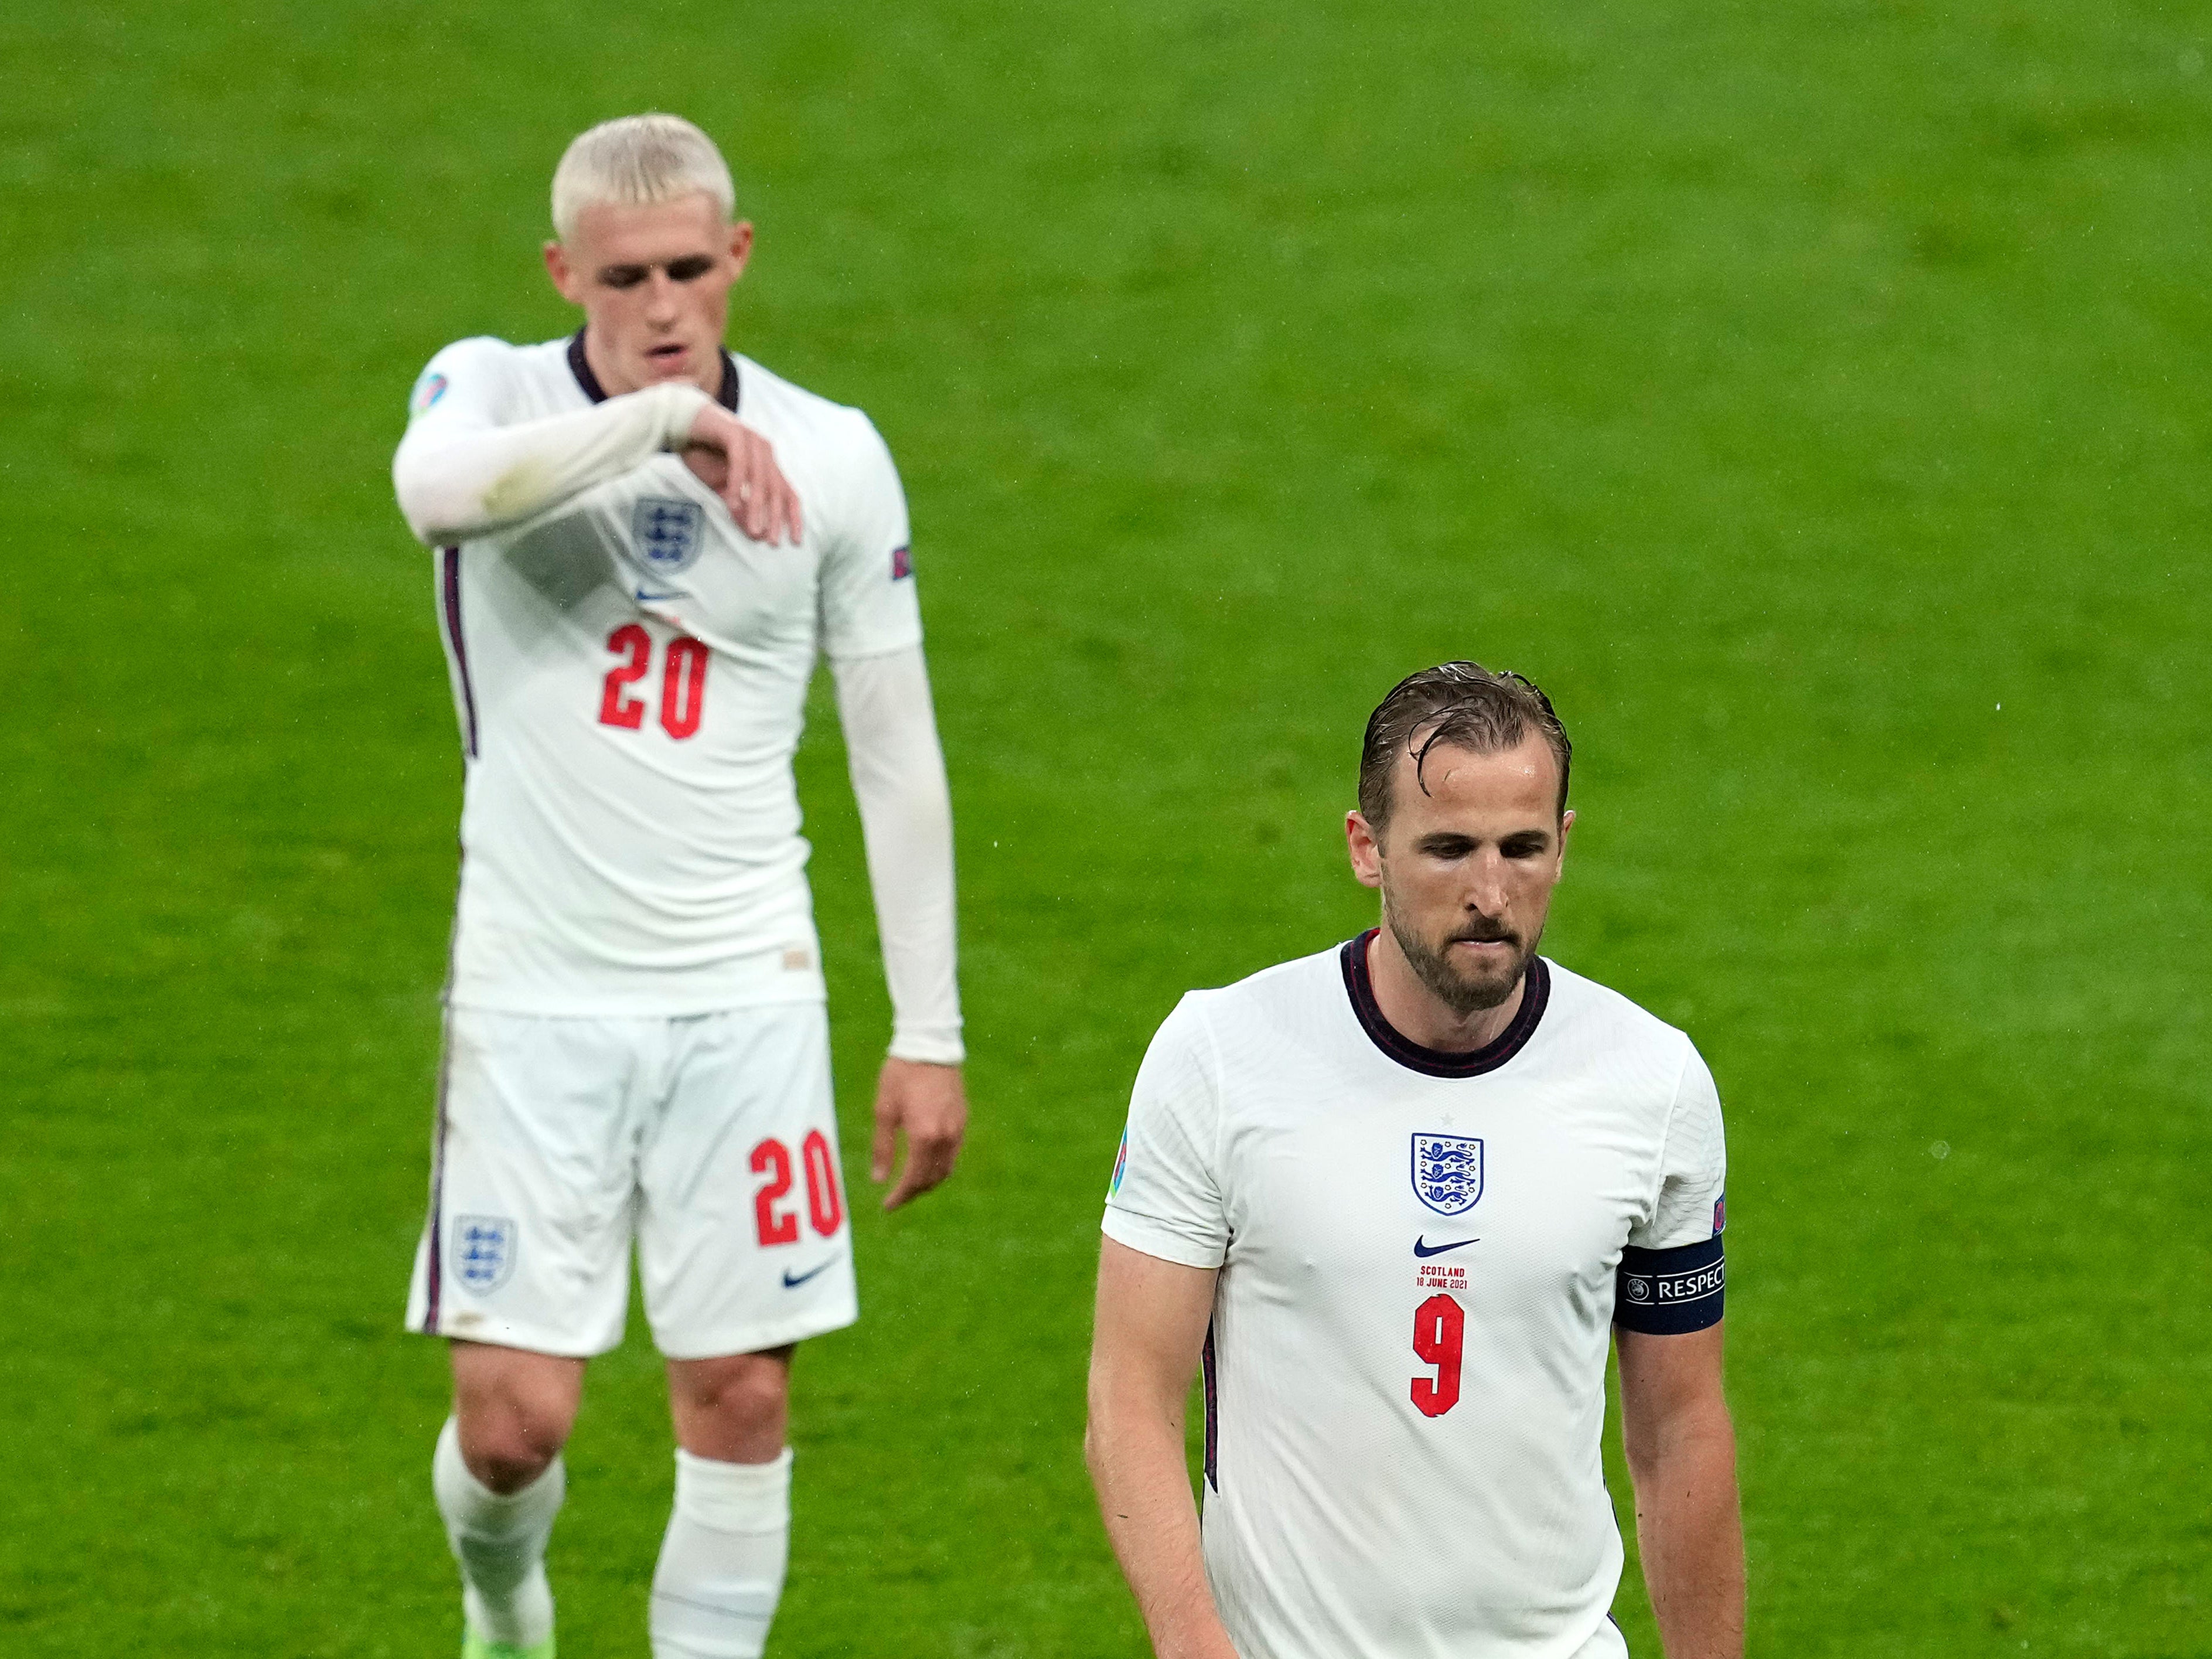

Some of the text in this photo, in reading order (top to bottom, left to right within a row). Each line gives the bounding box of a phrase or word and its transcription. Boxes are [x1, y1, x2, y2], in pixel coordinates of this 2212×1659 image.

[599, 624, 710, 740] 20
[750, 1128, 841, 1245] 20
[1417, 1277, 1467, 1289] 18 JUNE 2021
[1420, 1265, 1465, 1278] SCOTLAND
[1410, 1293, 1465, 1418] 9
